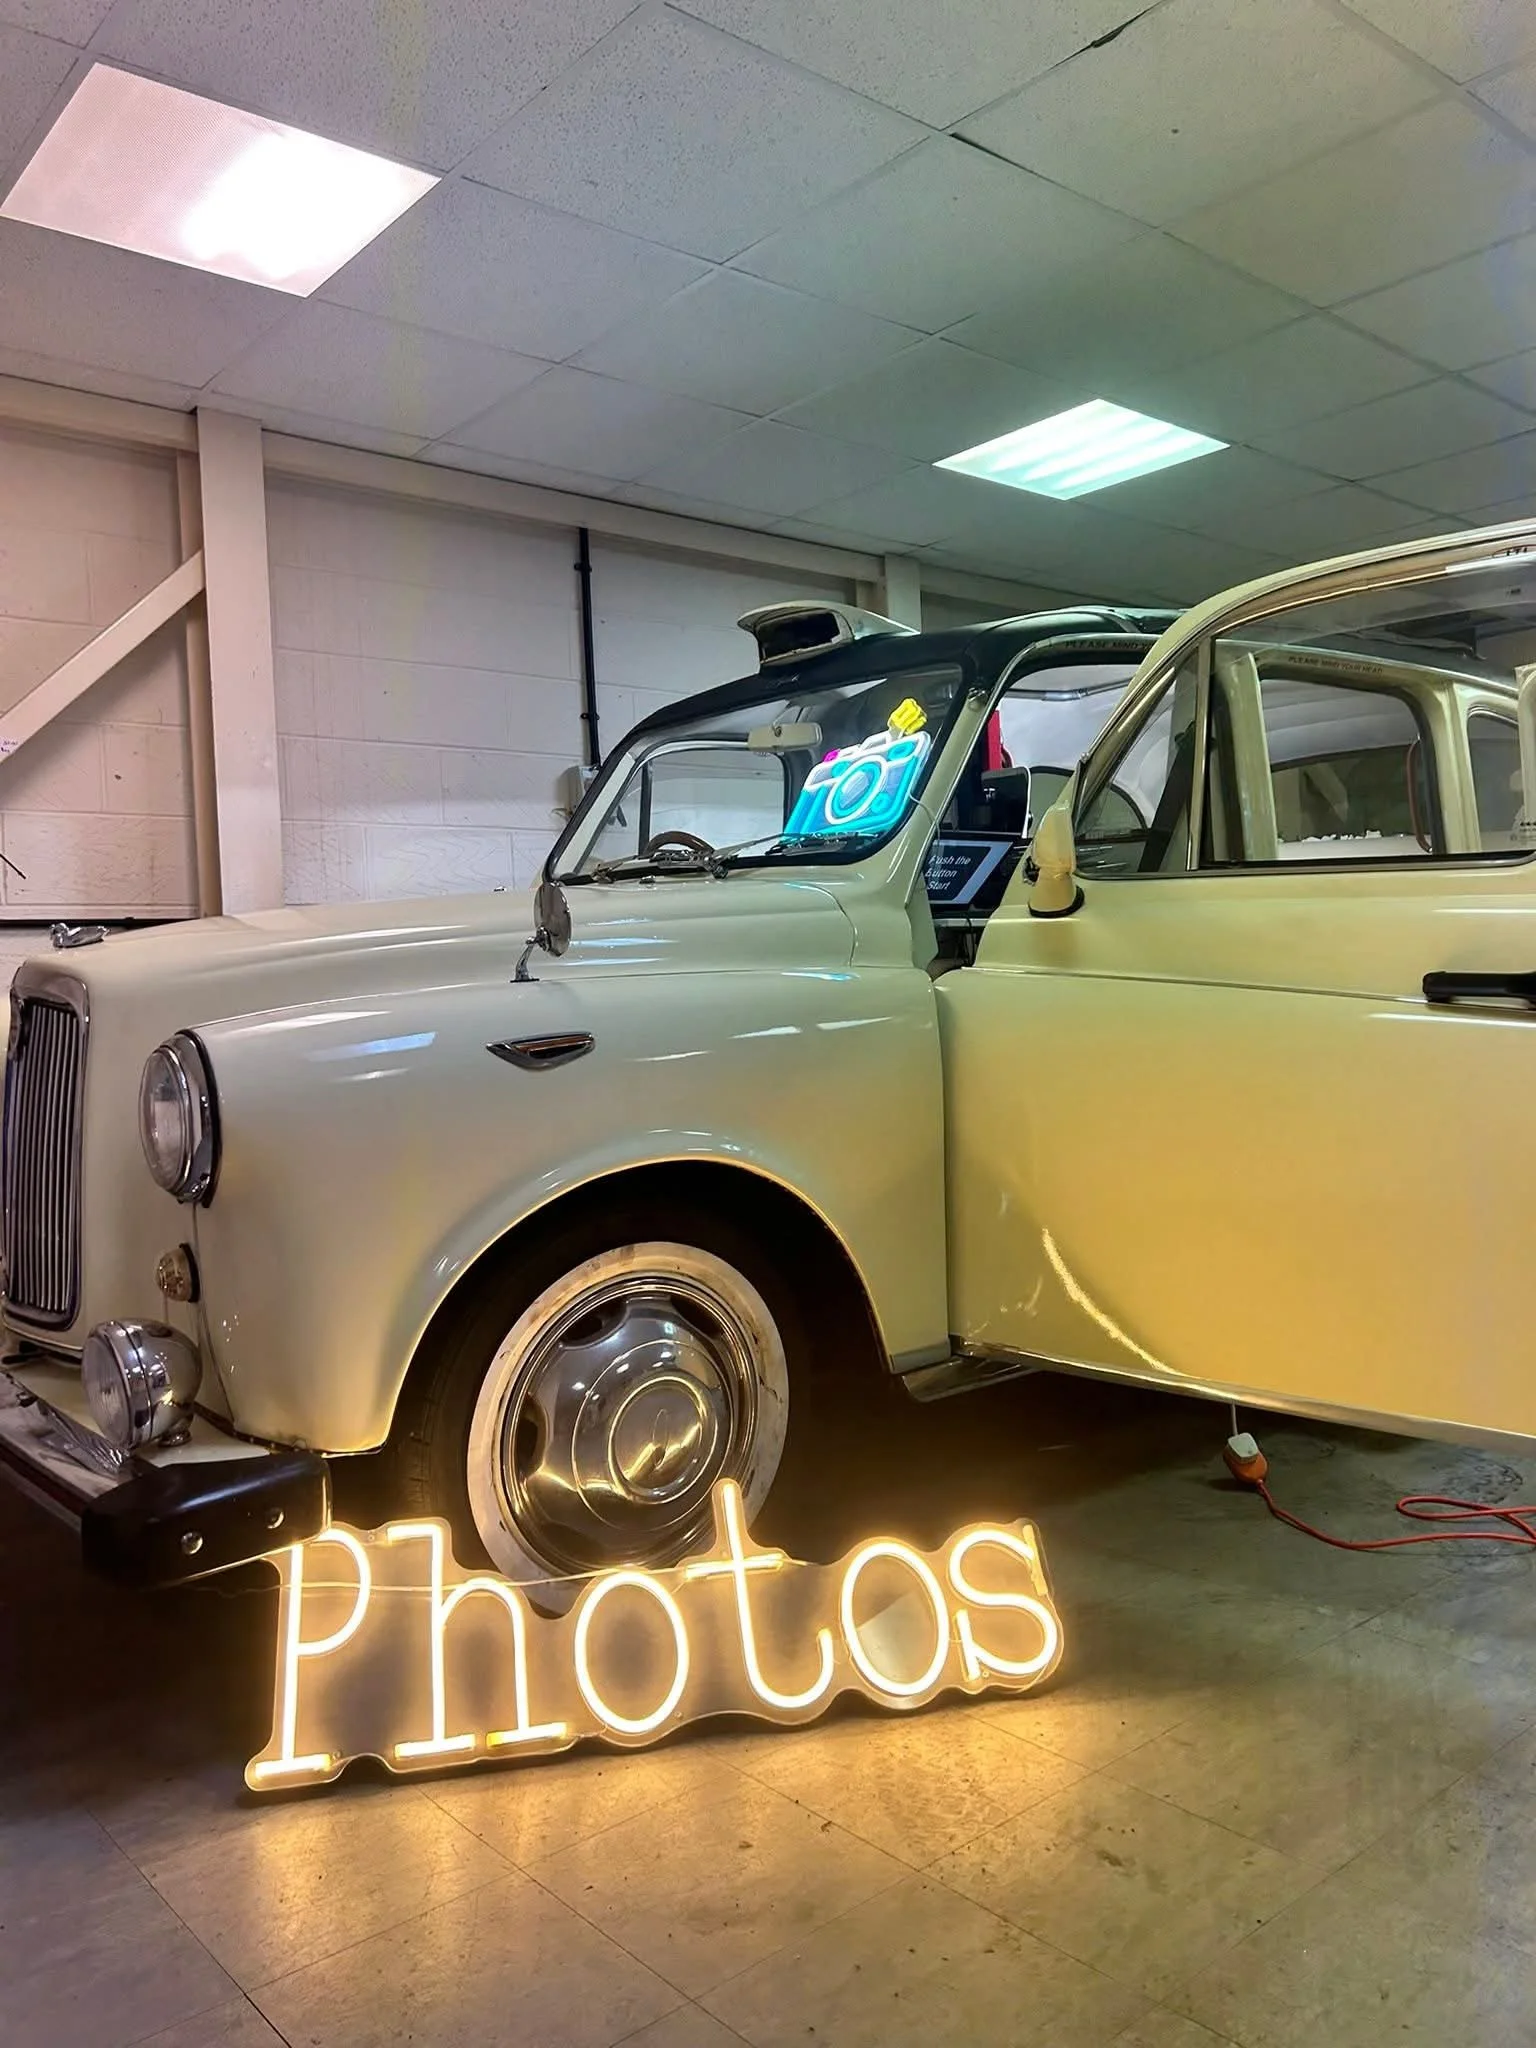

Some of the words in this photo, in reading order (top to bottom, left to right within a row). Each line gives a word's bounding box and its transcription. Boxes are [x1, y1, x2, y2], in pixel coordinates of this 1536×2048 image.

[1064, 640, 1106, 649] PLEASE
[1287, 656, 1319, 665] PLEASE
[955, 855, 972, 865] the
[254, 1481, 1060, 1778] Photos
